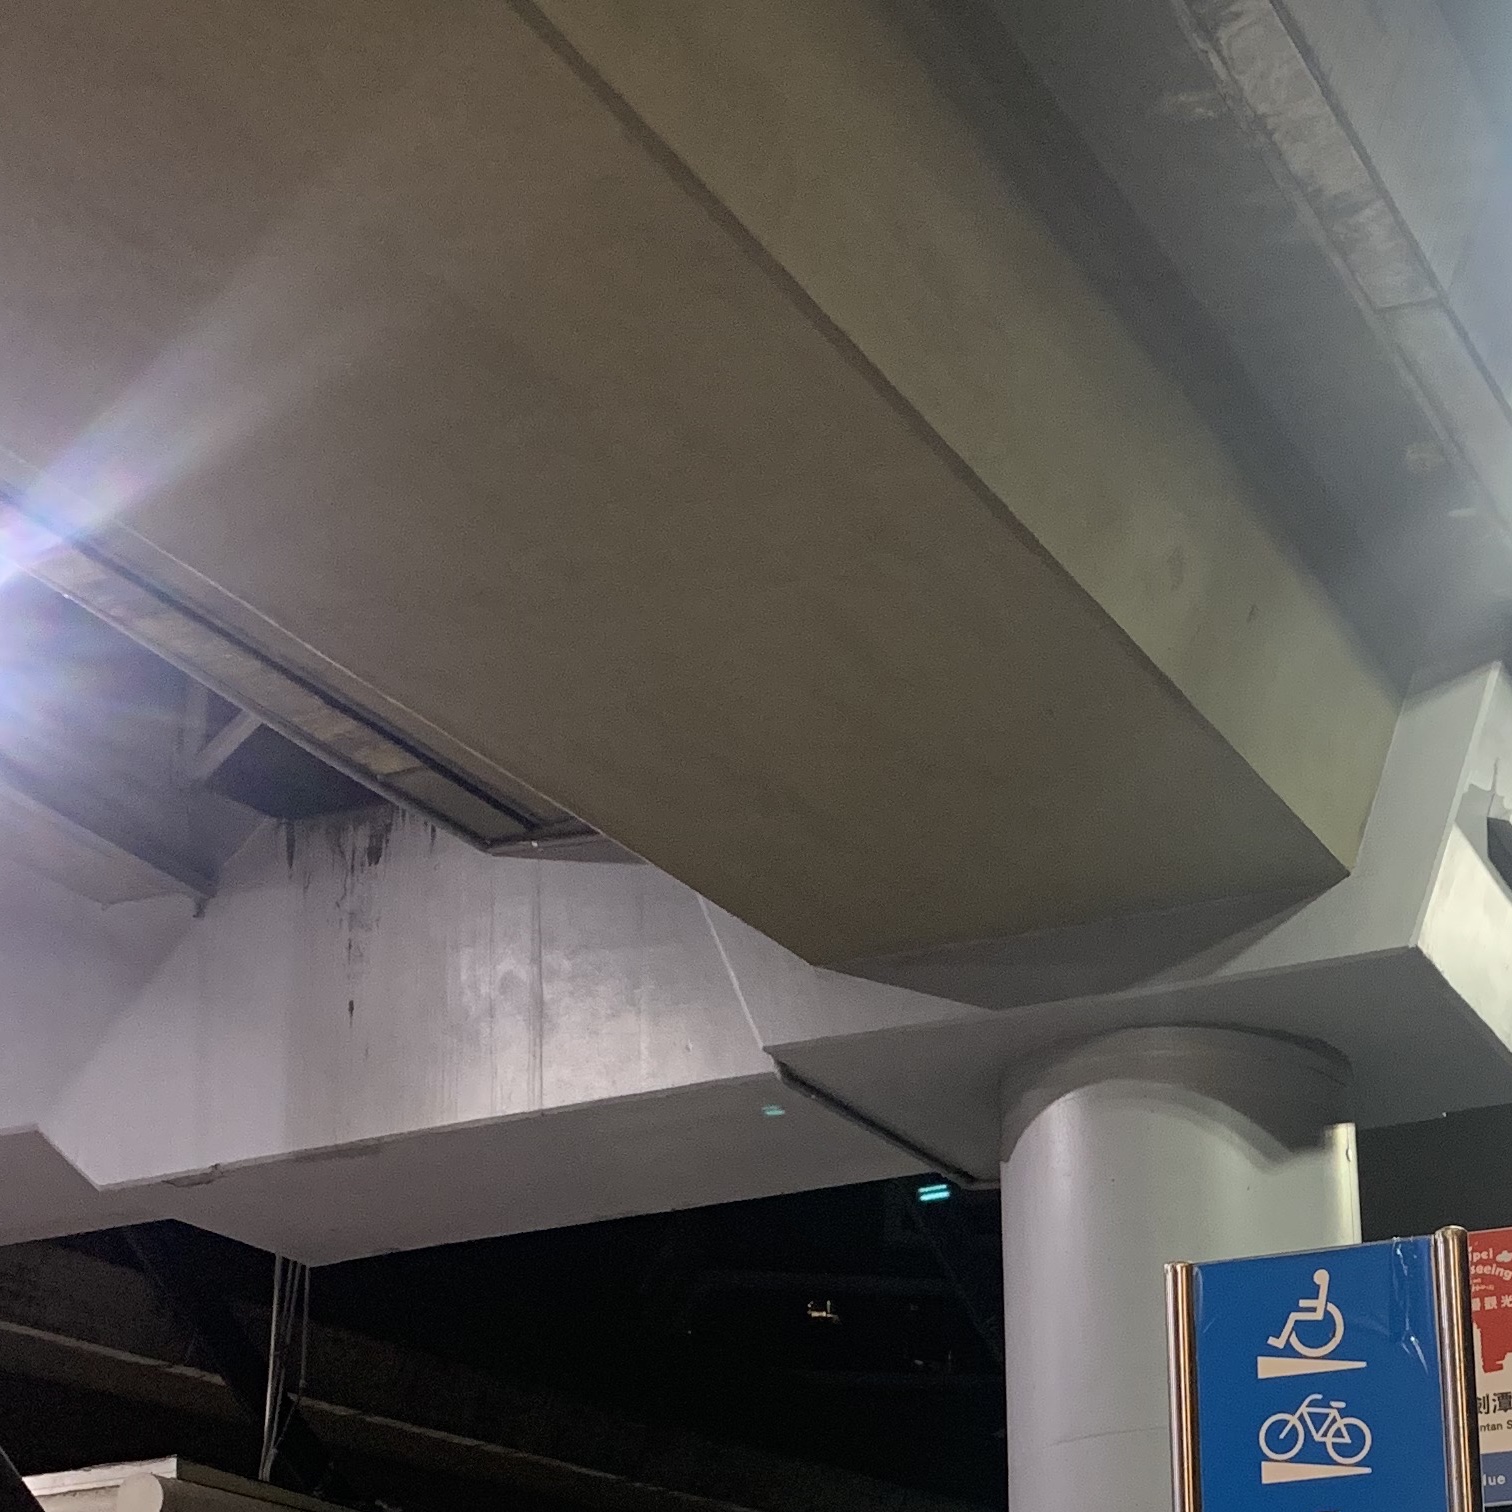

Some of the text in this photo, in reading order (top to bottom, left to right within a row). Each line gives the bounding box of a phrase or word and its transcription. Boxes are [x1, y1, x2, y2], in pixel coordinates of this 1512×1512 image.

[1468, 1246, 1493, 1263] ipei
[1470, 1263, 1512, 1281] seeing
[1480, 1423, 1503, 1432] ntan
[1482, 1473, 1506, 1486] lue
